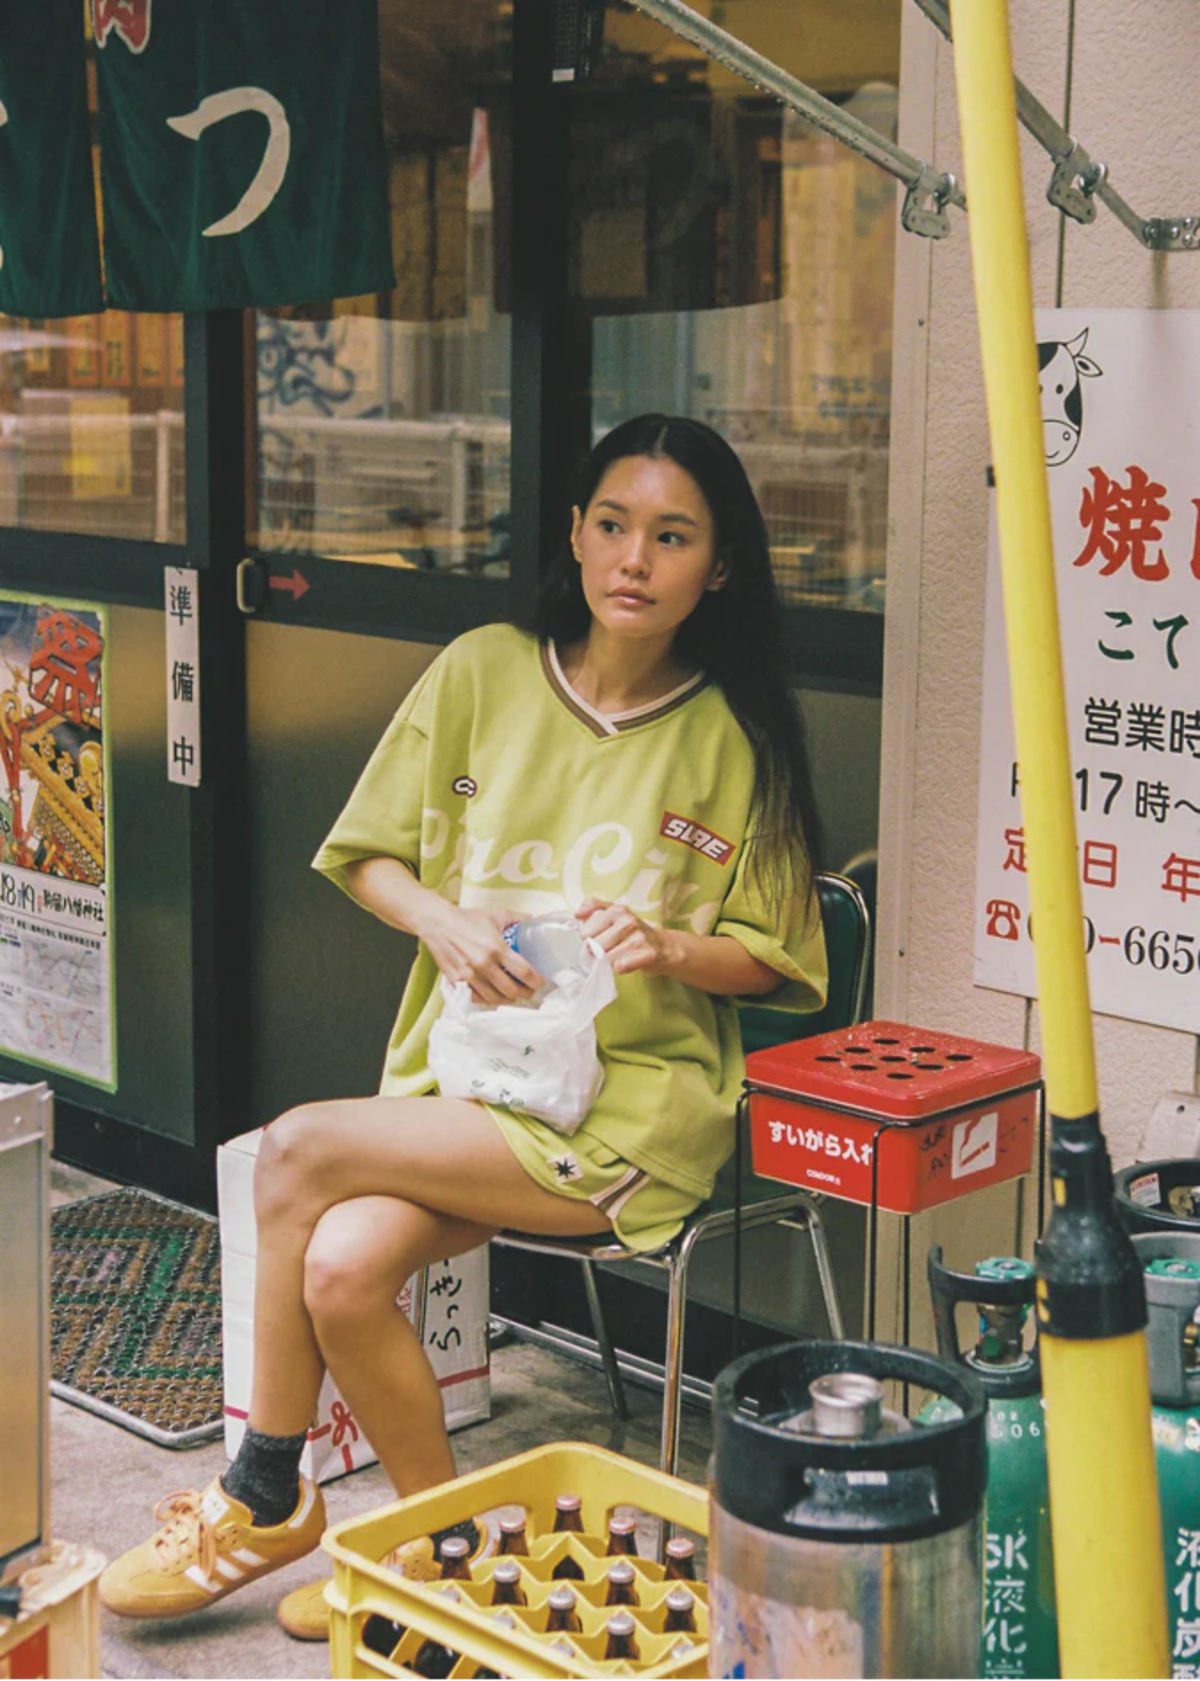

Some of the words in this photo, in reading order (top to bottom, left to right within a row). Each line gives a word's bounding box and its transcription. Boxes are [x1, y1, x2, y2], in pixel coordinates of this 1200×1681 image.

[166, 86, 291, 237] つ
[1073, 465, 1200, 582] 焼
[168, 584, 195, 777] 準備中
[1098, 611, 1190, 670] こて
[1003, 826, 1118, 889] 定日
